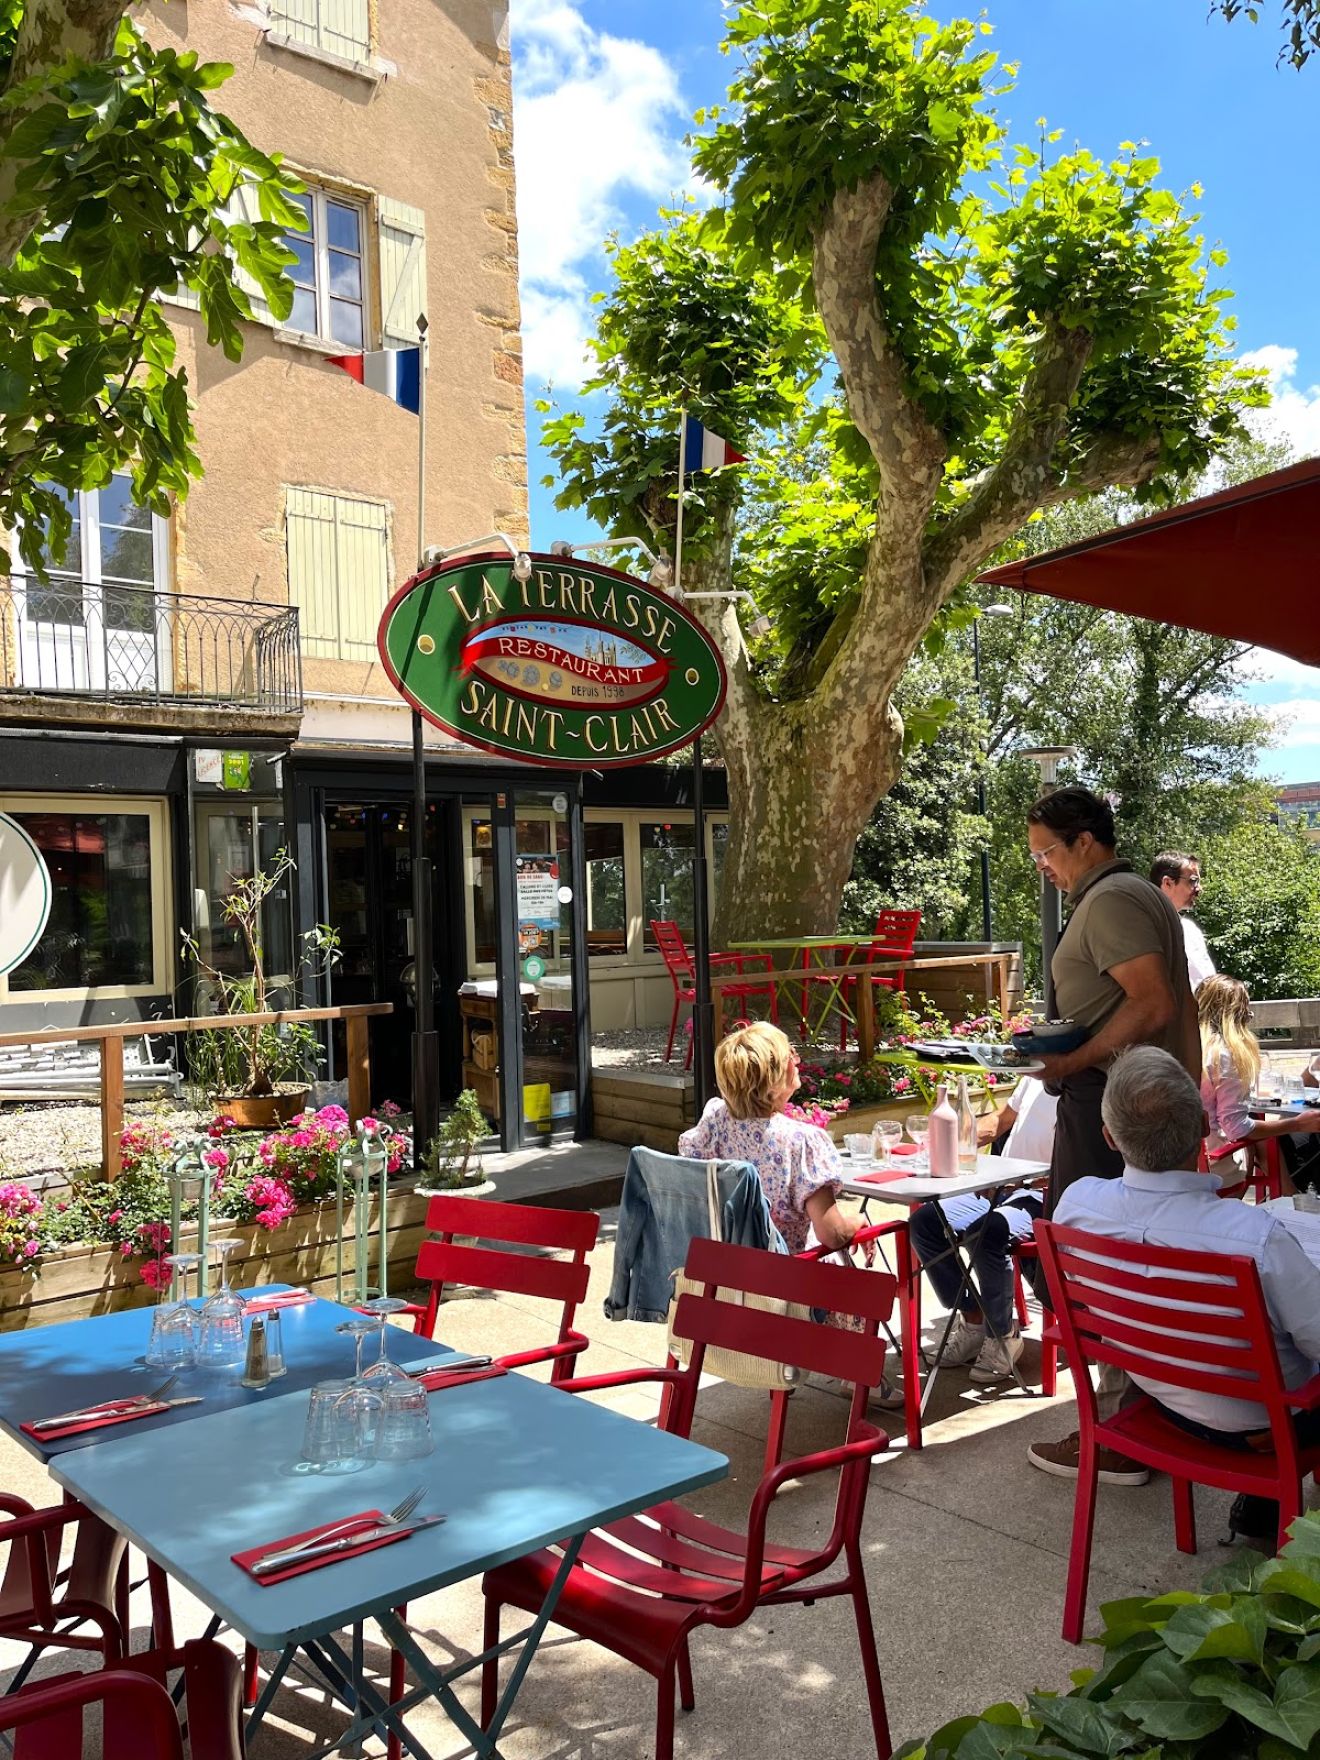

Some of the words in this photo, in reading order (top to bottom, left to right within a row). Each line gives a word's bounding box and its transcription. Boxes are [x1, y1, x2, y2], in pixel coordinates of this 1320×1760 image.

[448, 573, 506, 624] LA
[512, 570, 676, 654] TERRASSE
[499, 637, 643, 684] RESTAURANT
[571, 685, 599, 697] DEPUIS
